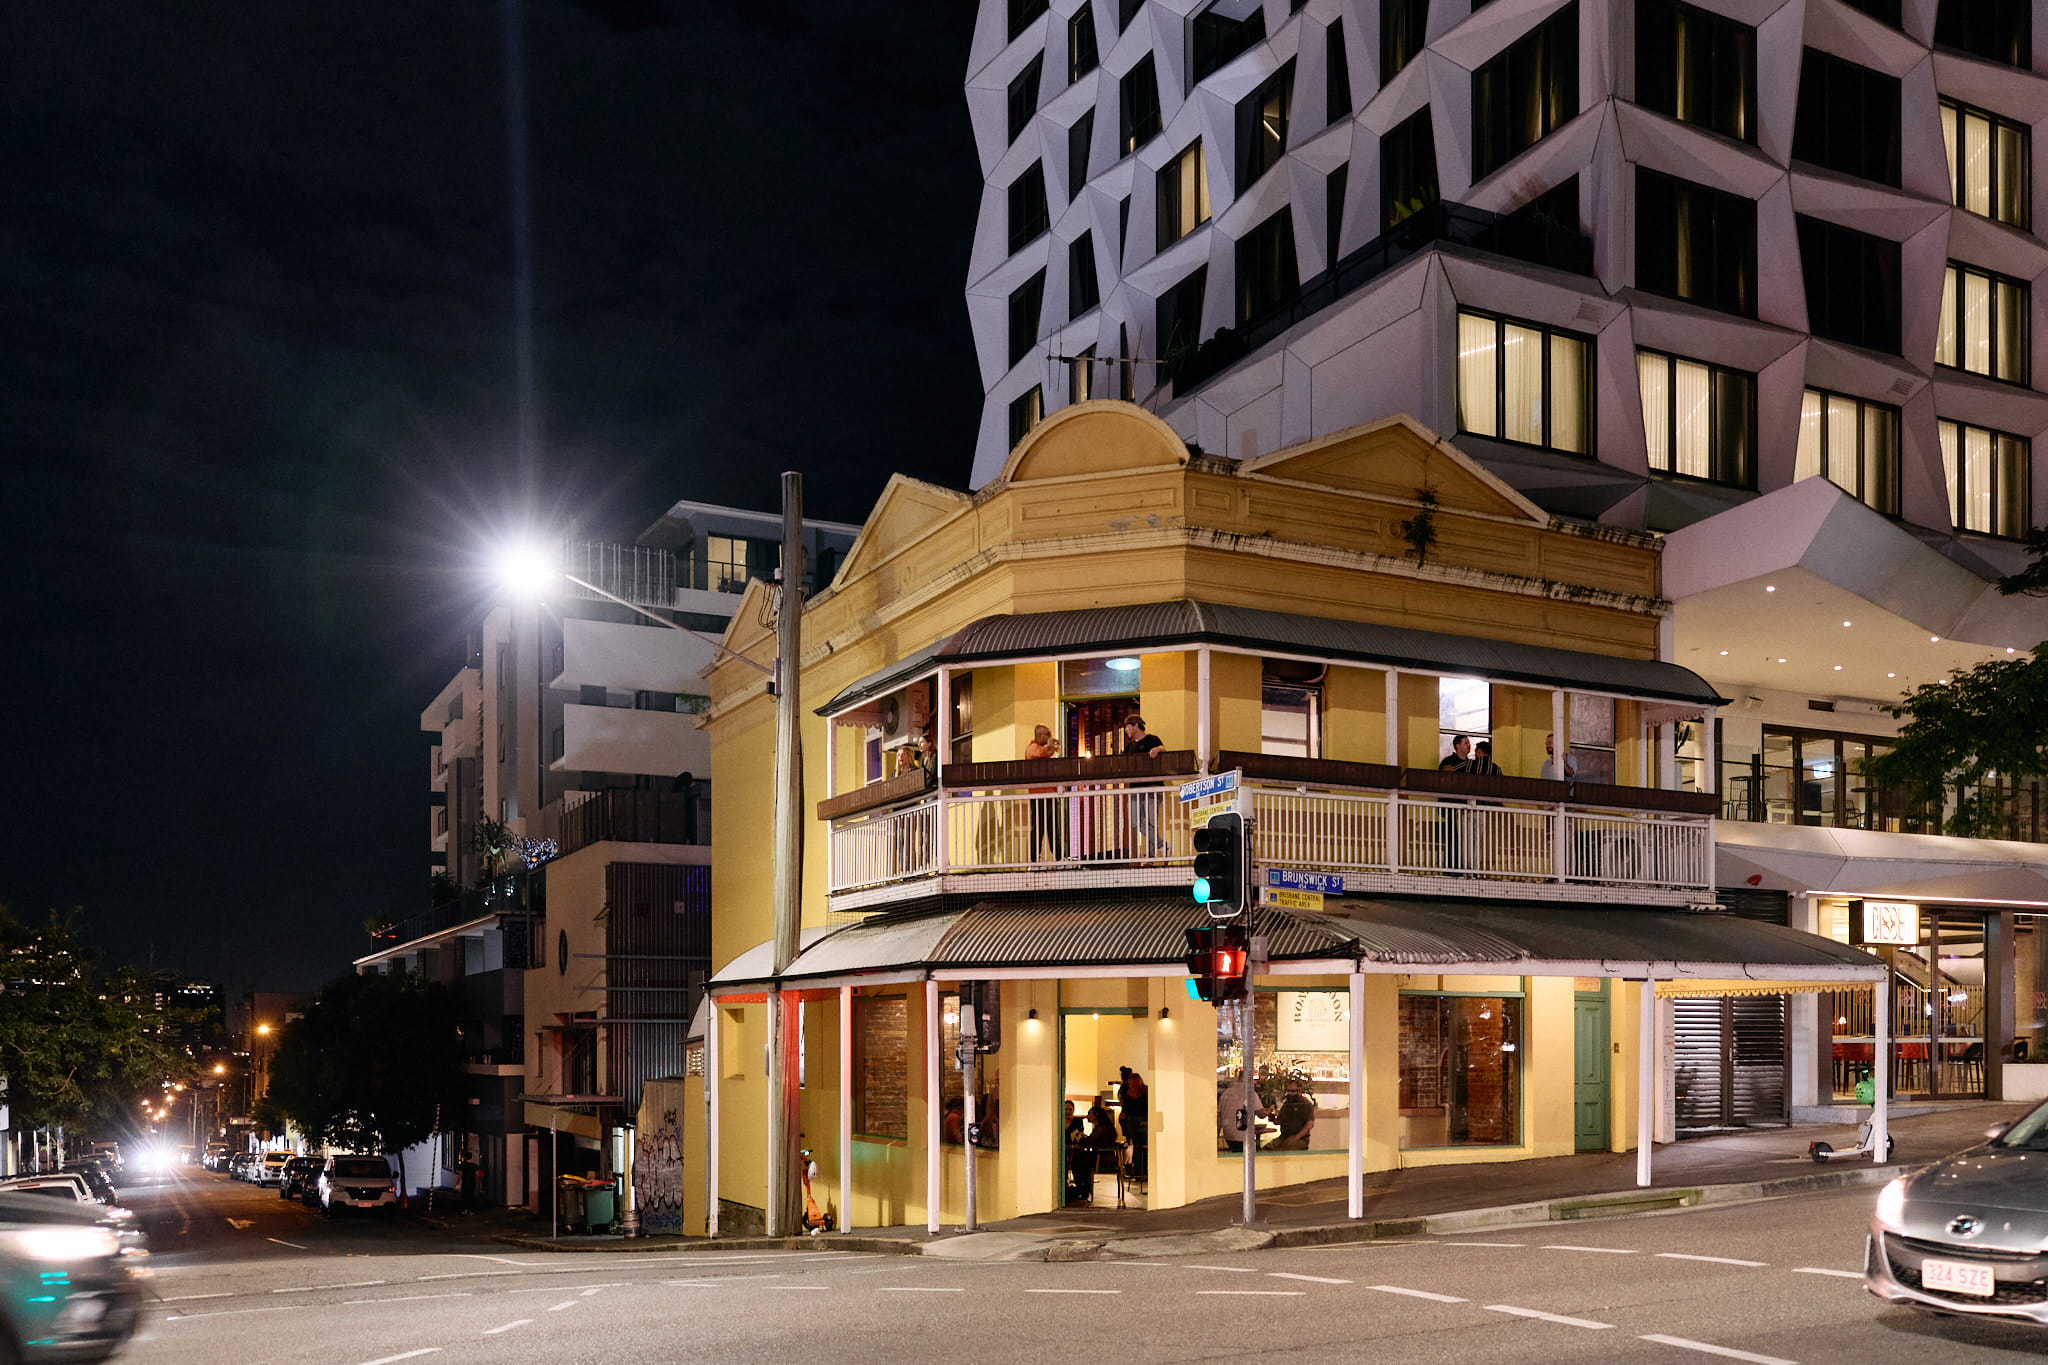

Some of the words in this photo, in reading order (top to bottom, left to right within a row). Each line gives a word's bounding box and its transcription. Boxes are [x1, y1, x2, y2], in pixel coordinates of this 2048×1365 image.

[1282, 871, 1328, 887] BRUNSWICK
[1279, 891, 1300, 899] BRISBANE
[1301, 893, 1321, 902] CENTRAL
[1279, 899, 1297, 907] TRAFFIC
